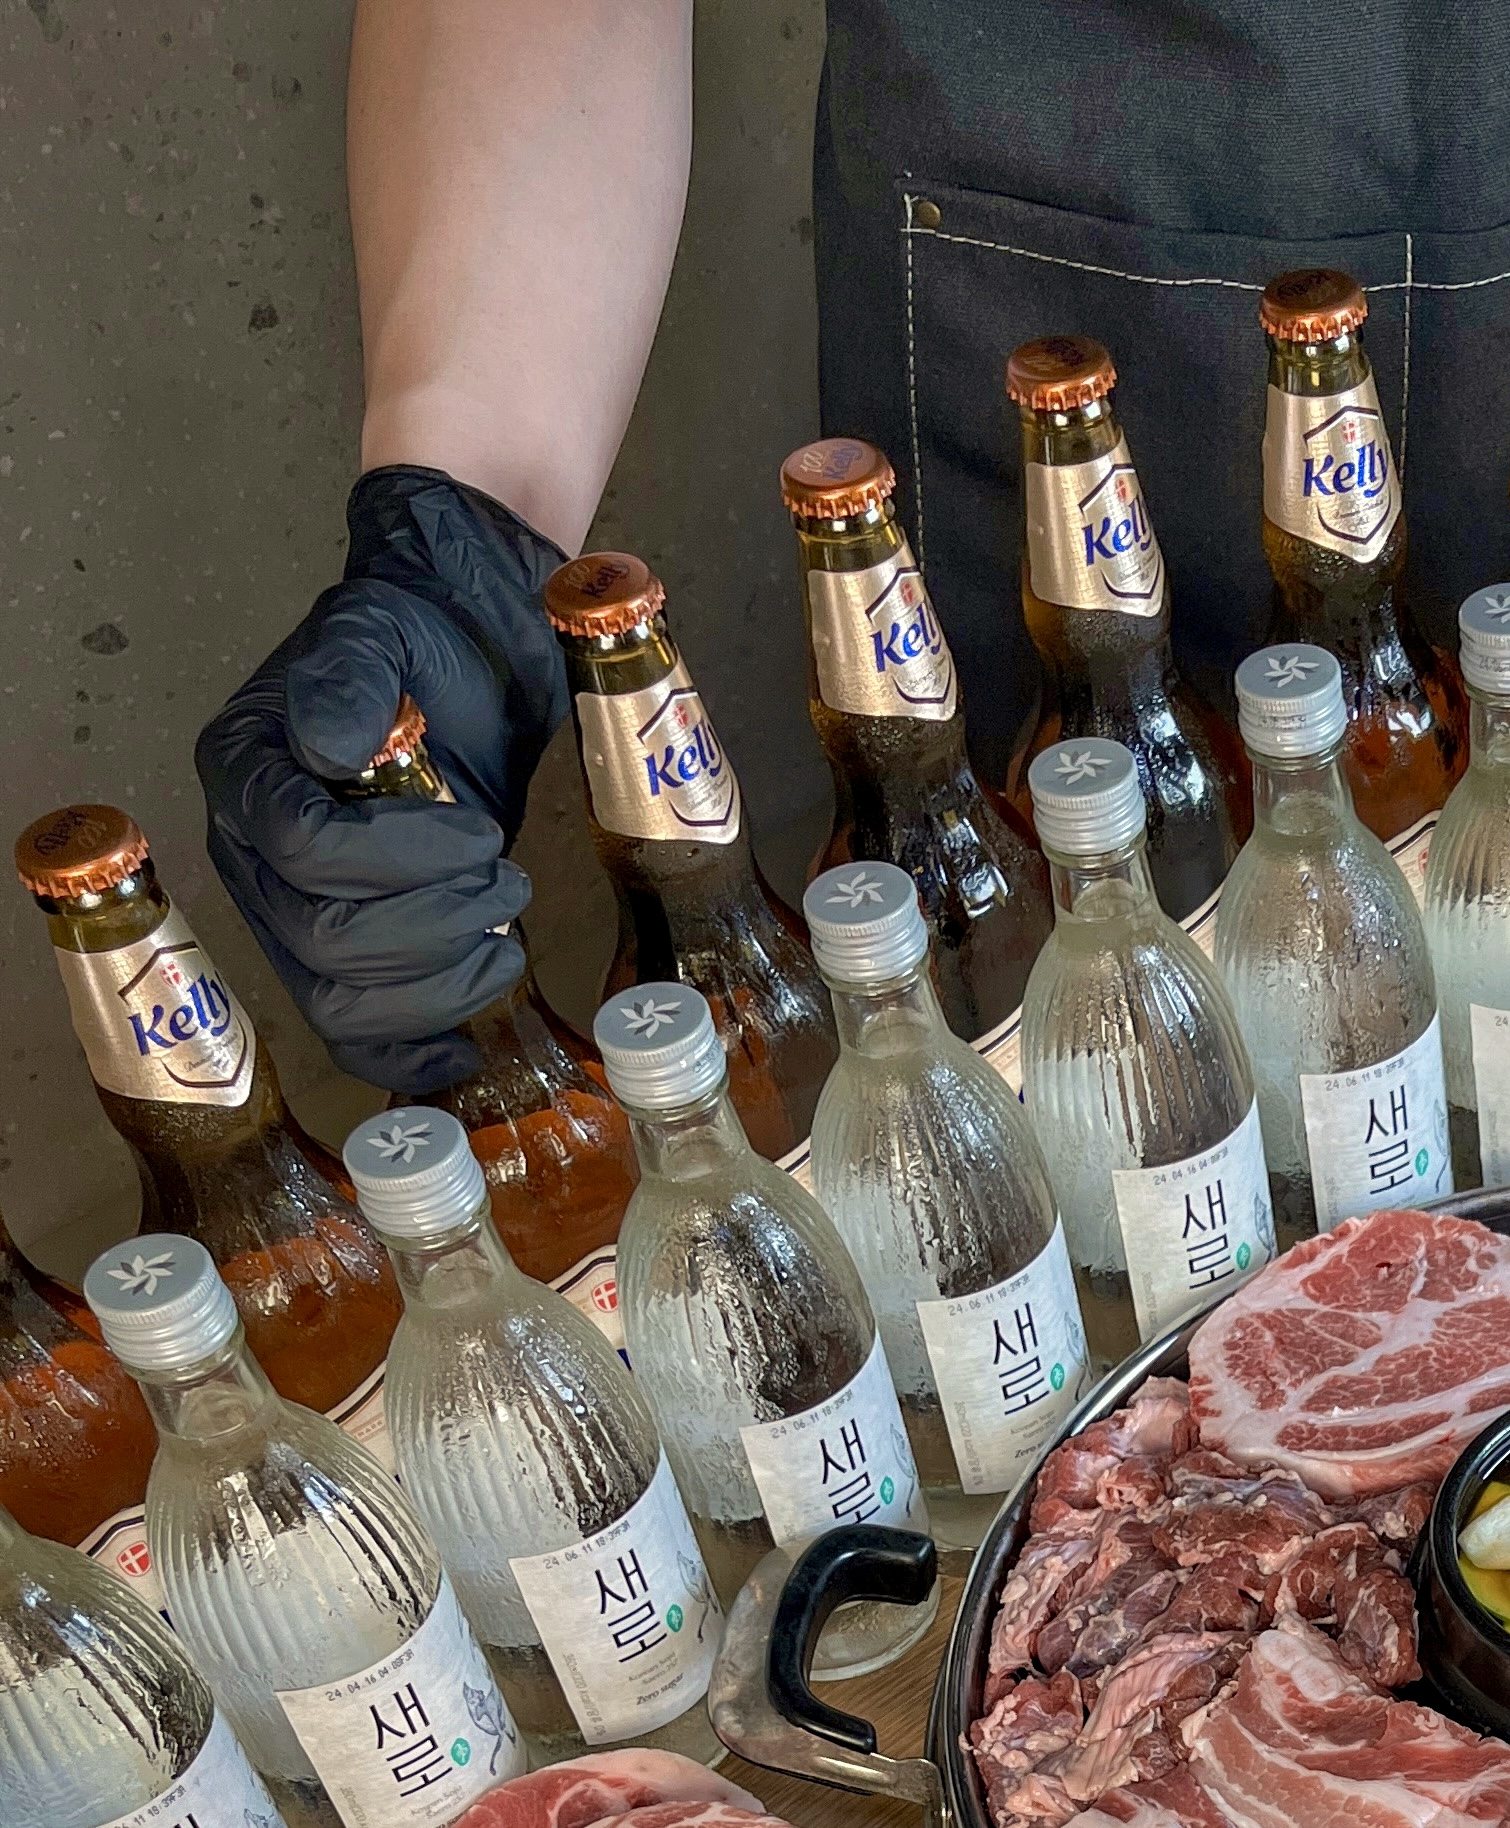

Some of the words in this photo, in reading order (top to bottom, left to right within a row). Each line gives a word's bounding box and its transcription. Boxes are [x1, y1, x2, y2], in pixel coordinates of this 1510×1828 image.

[1302, 440, 1390, 498] Kelly
[128, 970, 230, 1056] Kelly
[1365, 1085, 1414, 1195] 새로
[1182, 1179, 1235, 1290] 새로
[993, 1302, 1050, 1415] 새로
[819, 1418, 881, 1524] 새로
[1014, 1445, 1037, 1459] Zero
[595, 1548, 668, 1663] 새로
[369, 1683, 453, 1797] 새로
[636, 1690, 660, 1706] Zero
[660, 1672, 684, 1692] sugar
